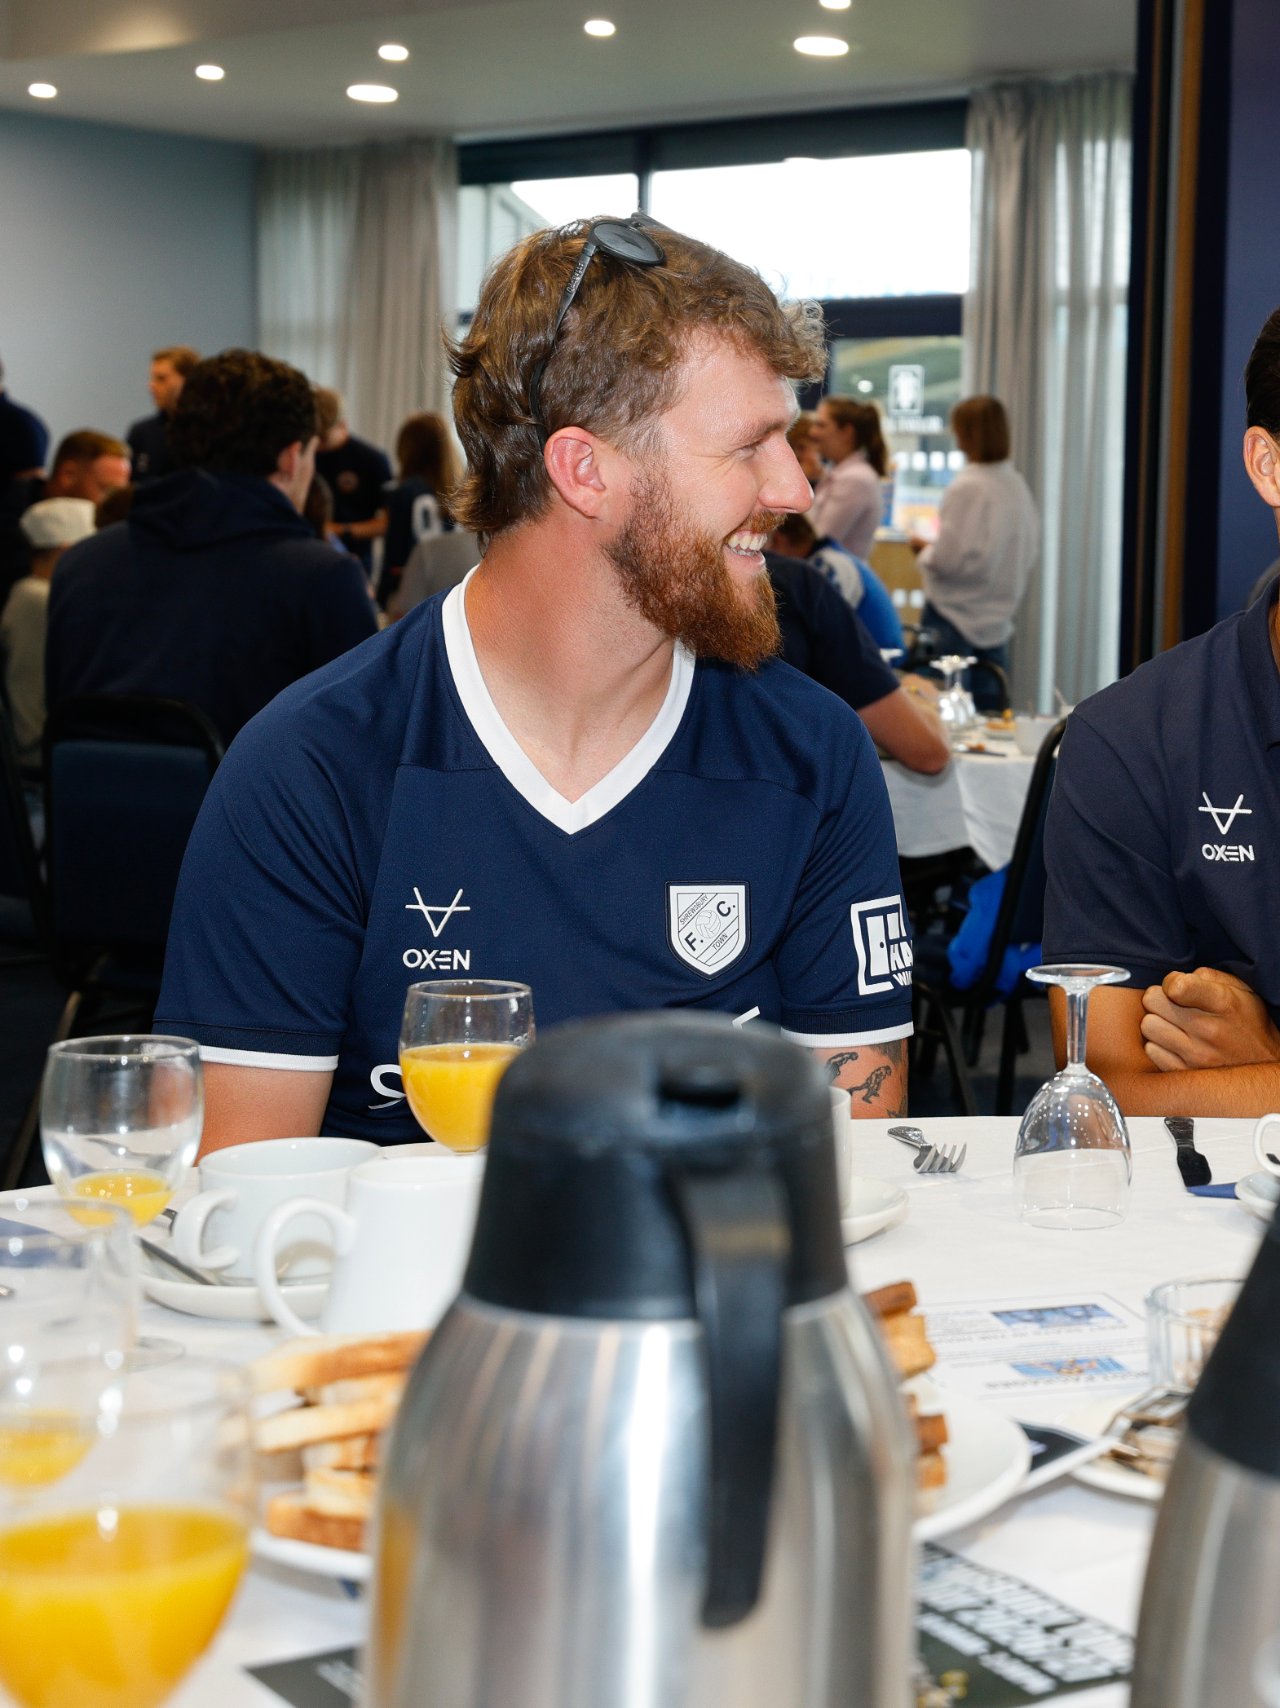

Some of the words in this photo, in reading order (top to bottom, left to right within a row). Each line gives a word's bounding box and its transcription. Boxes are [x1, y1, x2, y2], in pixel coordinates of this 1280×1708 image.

[1202, 843, 1255, 862] OXEN
[679, 894, 709, 925] SHREWSBURY
[712, 933, 728, 950] TOWN
[402, 948, 471, 970] OXEN
